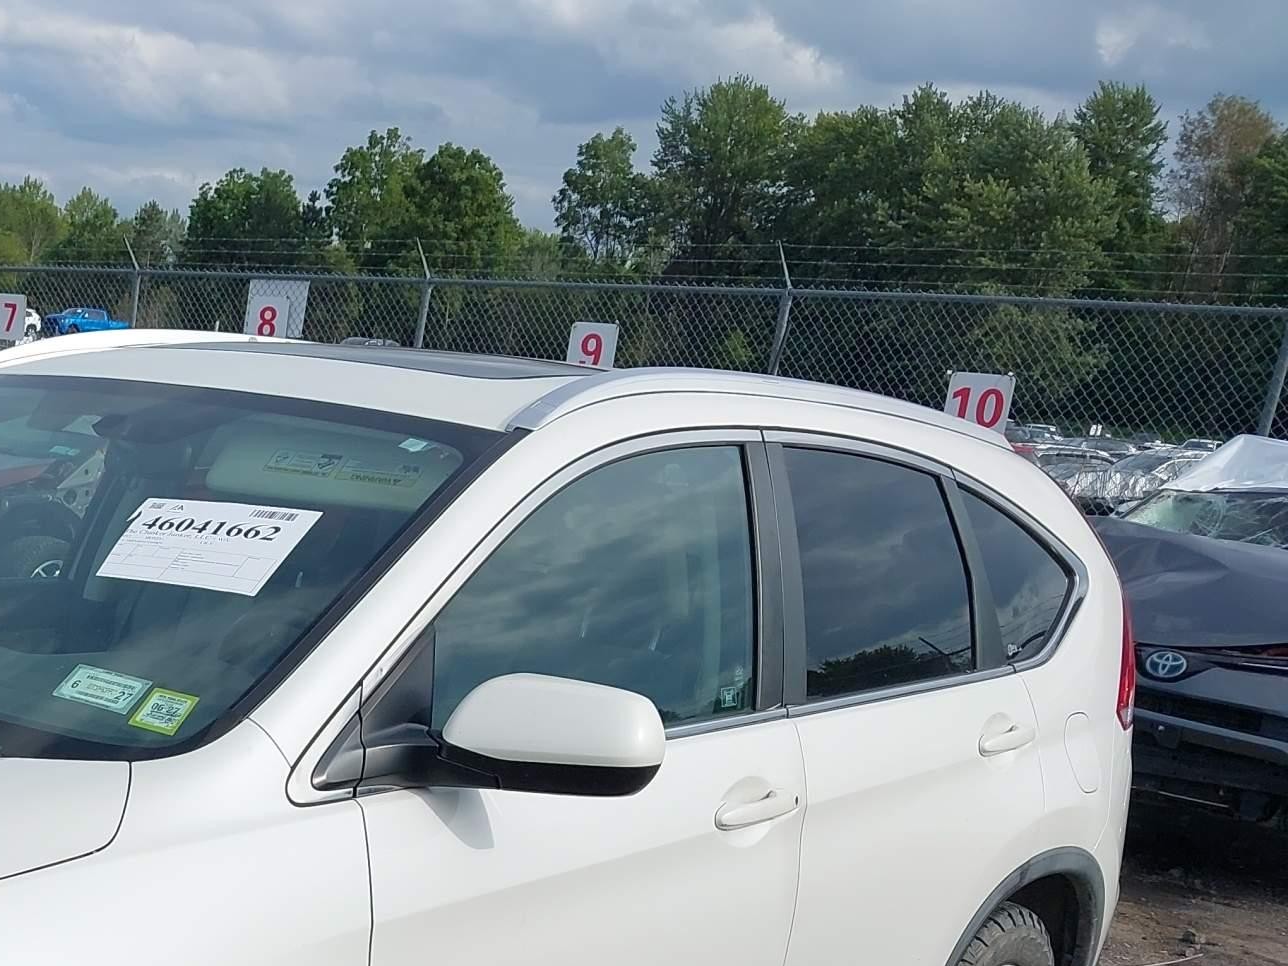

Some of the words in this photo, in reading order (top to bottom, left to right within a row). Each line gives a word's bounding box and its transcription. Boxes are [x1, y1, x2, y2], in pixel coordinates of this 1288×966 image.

[3, 302, 18, 332] 7
[258, 306, 278, 337] 8
[578, 332, 603, 367] 9
[952, 386, 1005, 429] 10
[141, 515, 282, 542] 46041662
[114, 690, 133, 702] 27
